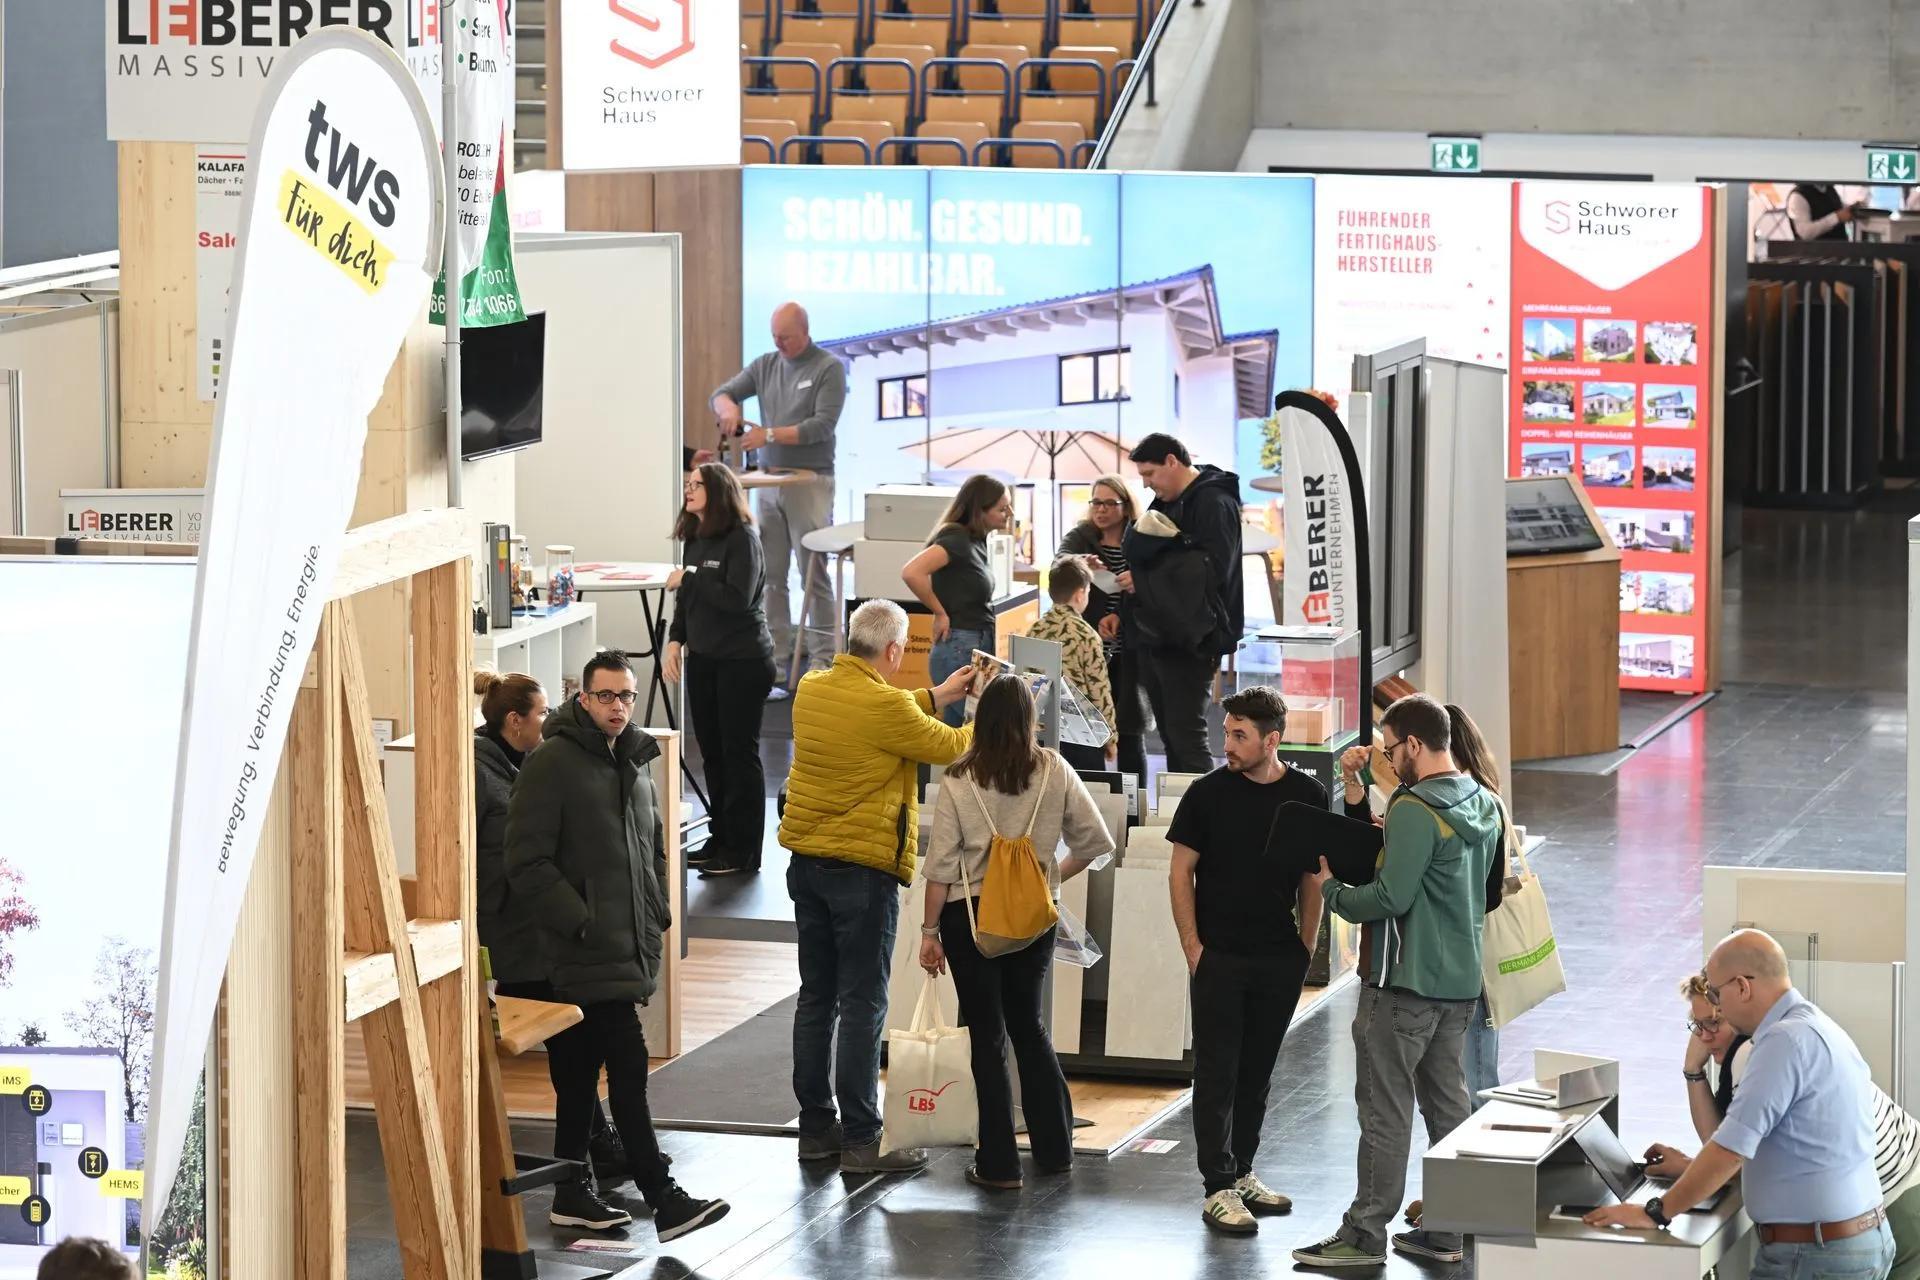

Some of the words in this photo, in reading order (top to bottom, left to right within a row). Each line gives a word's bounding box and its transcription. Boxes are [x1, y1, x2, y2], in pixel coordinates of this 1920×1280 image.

[603, 107, 657, 124] Haus
[305, 99, 399, 227] tws
[198, 176, 226, 184] Dächer
[783, 192, 922, 242] SCHÖN.
[930, 199, 1092, 246] GESUND.
[1578, 220, 1631, 236] Haus
[329, 221, 378, 286] dich.
[784, 250, 1005, 296] BEZAHLBAR.
[1338, 255, 1433, 274] HERSTELLER
[481, 265, 509, 285] Fon:
[484, 293, 517, 315] 1066
[247, 630, 296, 751] Verbindung.
[286, 545, 320, 623] Energie.
[2, 1076, 21, 1085] iMS
[909, 1096, 936, 1112] LBS
[109, 1179, 139, 1189] HEMS
